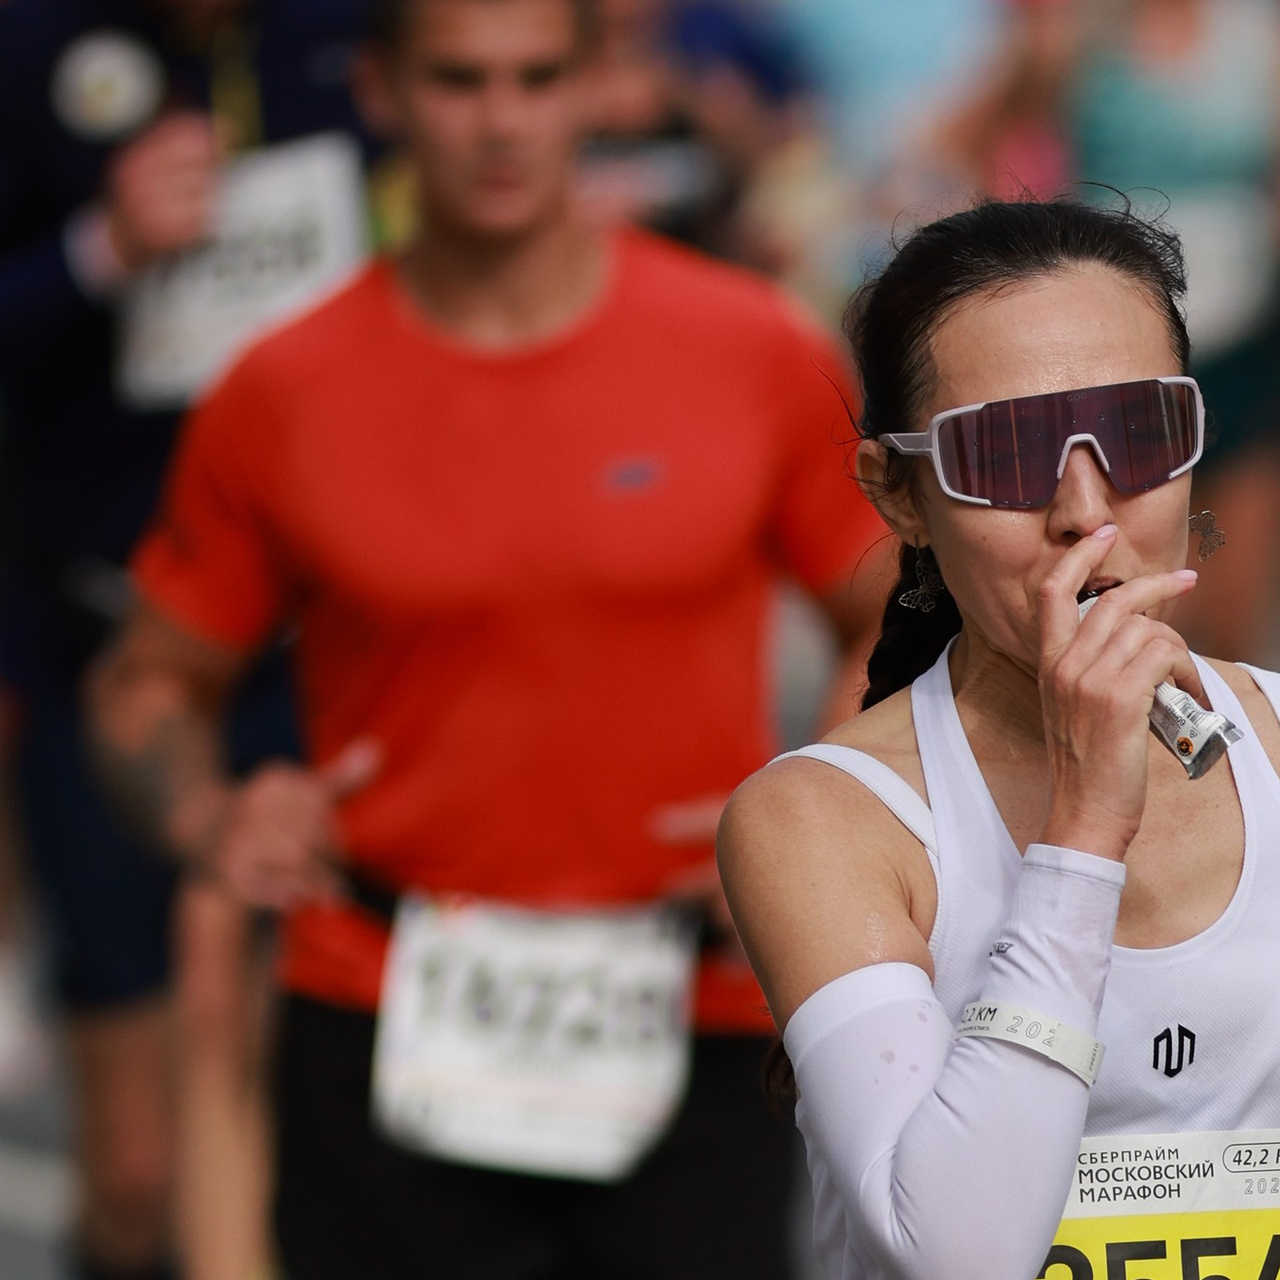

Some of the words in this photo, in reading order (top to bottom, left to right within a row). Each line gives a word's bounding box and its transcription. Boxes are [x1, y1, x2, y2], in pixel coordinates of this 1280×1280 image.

[1078, 1148, 1180, 1165] СБЕРПРАЙМ
[1232, 1149, 1269, 1168] 42,2
[1078, 1159, 1215, 1185] МОСКОВСКИЙ
[1079, 1183, 1181, 1203] МАРАФОН
